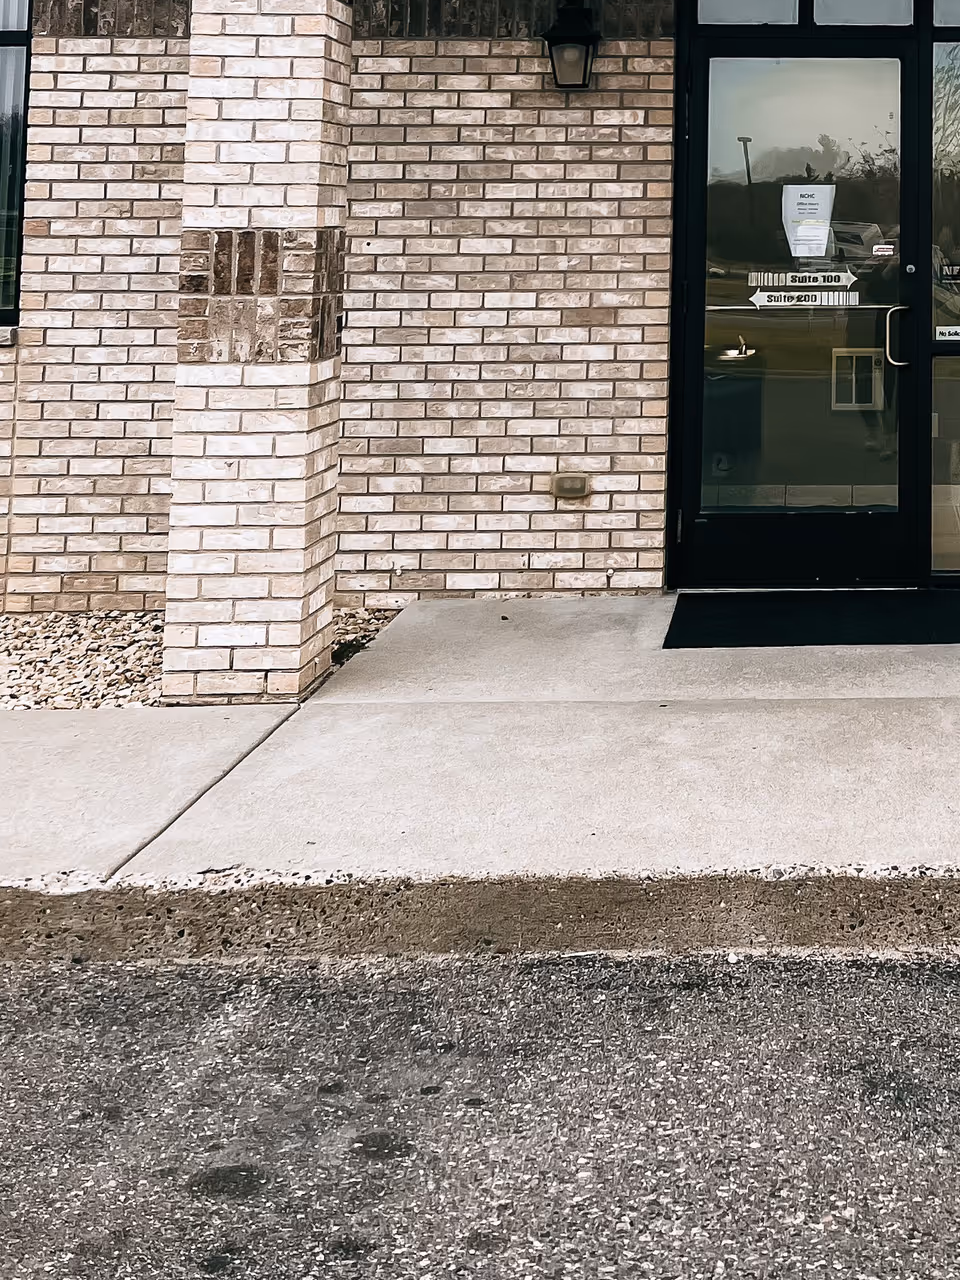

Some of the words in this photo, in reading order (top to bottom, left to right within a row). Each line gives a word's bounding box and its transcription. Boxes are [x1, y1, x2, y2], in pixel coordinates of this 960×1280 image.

[790, 275, 819, 283] Suite
[821, 275, 841, 283] 100
[766, 294, 794, 303] Suite
[795, 294, 817, 303] 200
